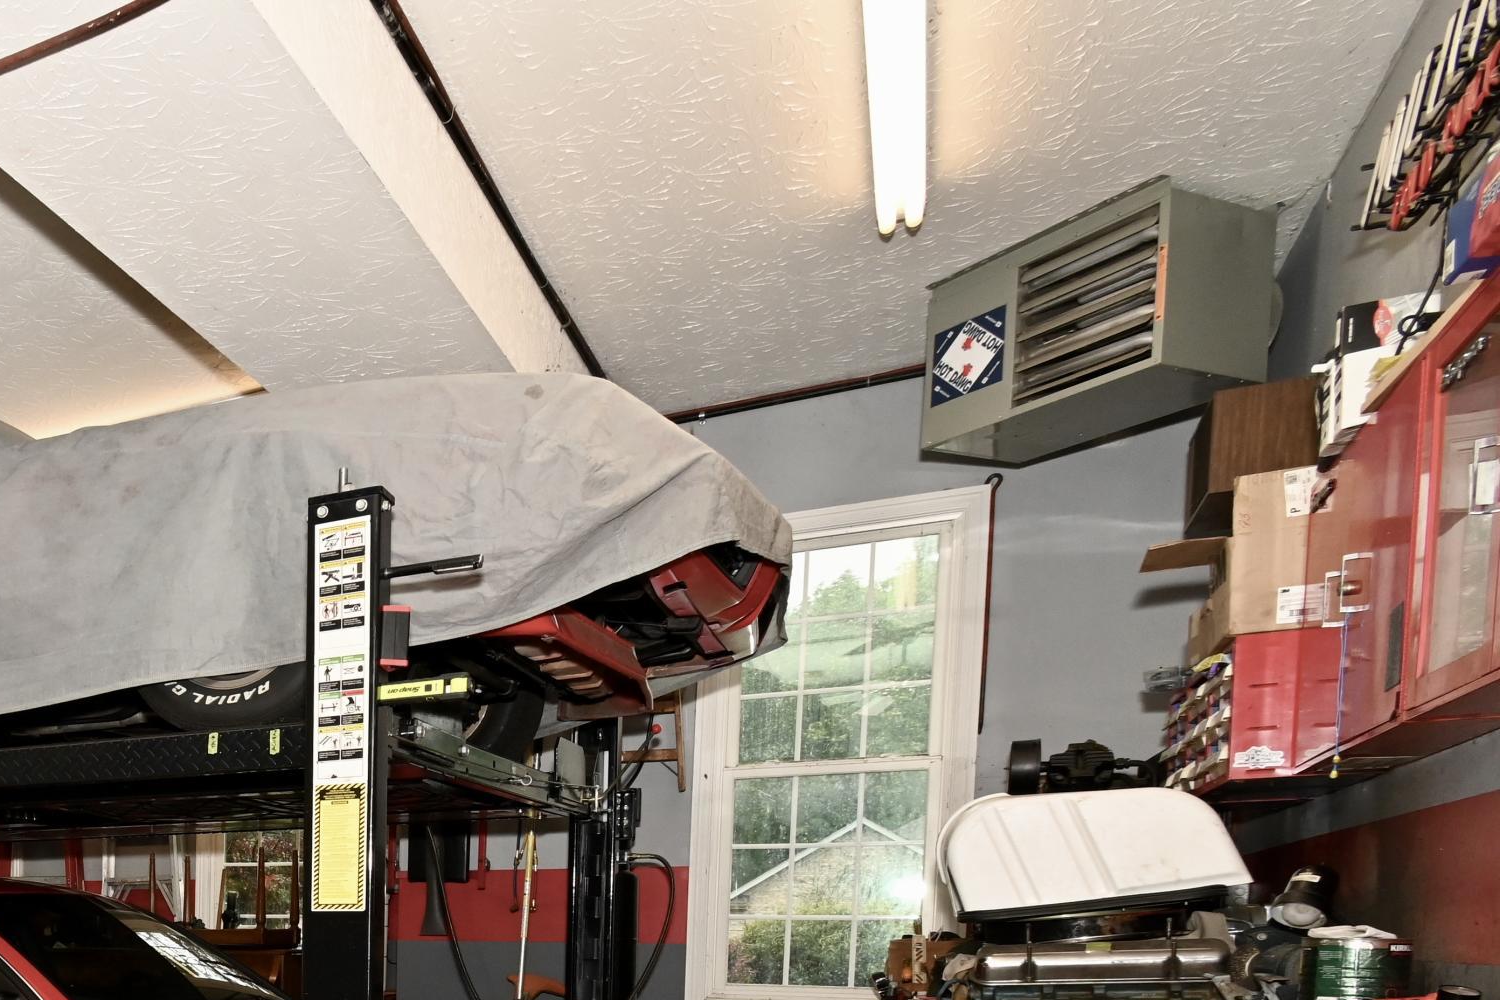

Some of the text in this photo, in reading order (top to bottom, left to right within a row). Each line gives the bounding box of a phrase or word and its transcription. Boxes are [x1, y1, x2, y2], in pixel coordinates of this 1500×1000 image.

[982, 337, 1003, 354] HOT
[934, 361, 954, 378] HOT
[948, 371, 973, 392] DAWG
[192, 680, 271, 705] RADIAL
[386, 686, 421, 695] Snap-on
